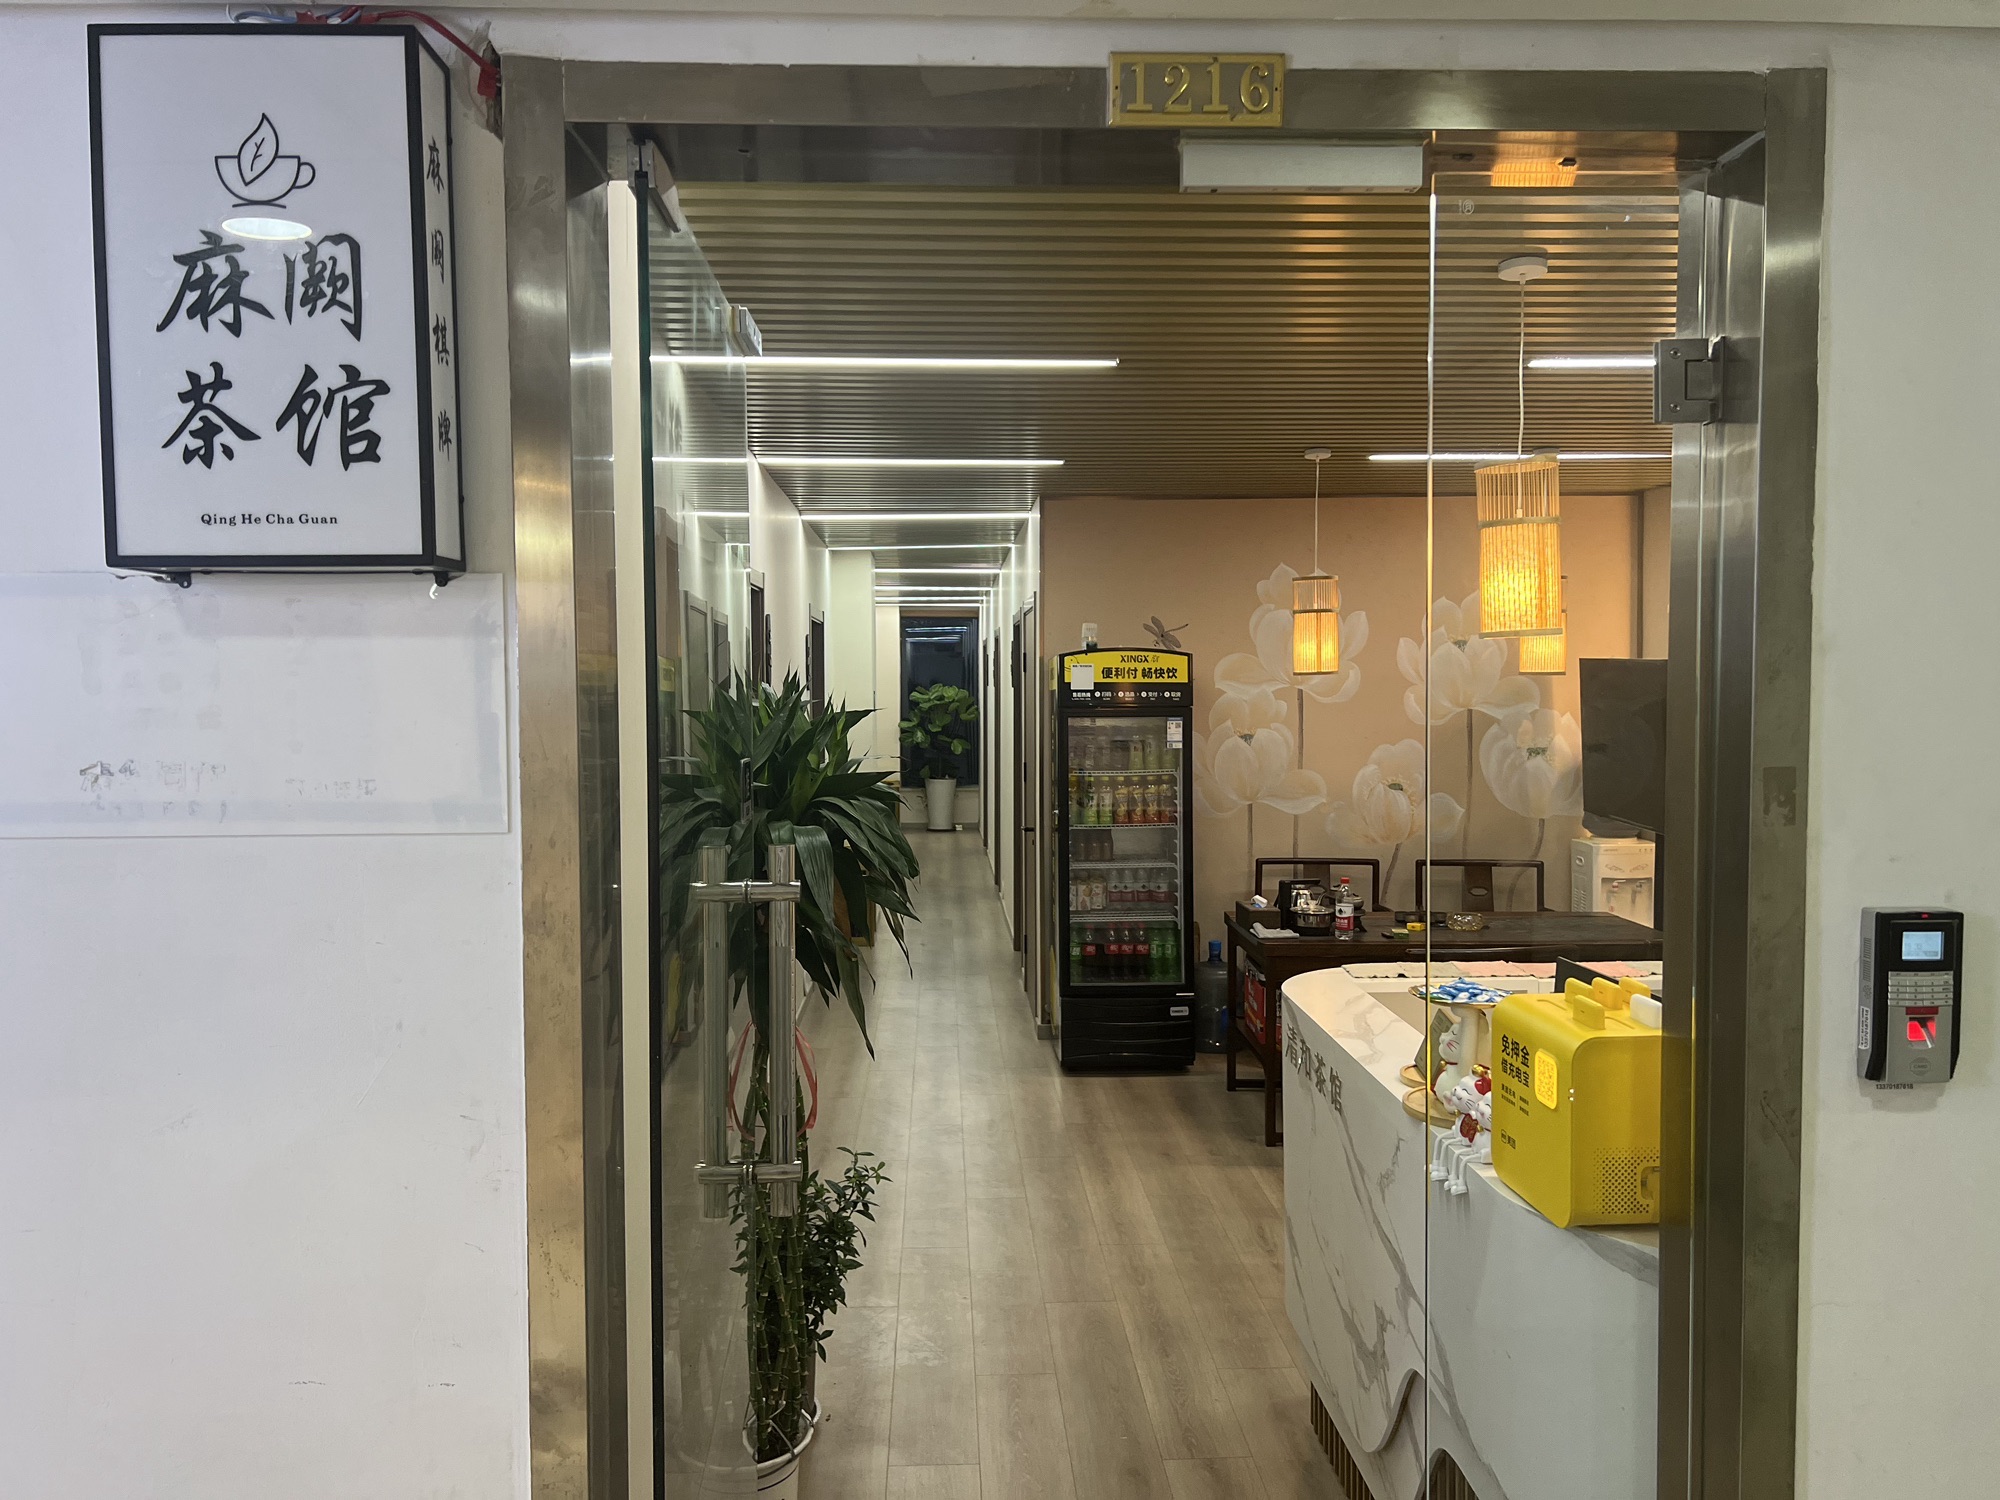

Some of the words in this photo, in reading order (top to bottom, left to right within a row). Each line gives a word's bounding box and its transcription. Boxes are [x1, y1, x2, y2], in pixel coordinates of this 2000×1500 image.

[1126, 62, 1270, 114] 1216
[162, 361, 391, 472] 茶馆
[200, 513, 237, 527] Qing
[241, 513, 262, 525] He
[265, 513, 295, 525] Cha
[298, 513, 338, 525] Guan
[1101, 667, 1138, 679] 便利付
[1141, 667, 1178, 679] 畅快饮
[1120, 654, 1149, 664] XINGX
[1501, 1034, 1530, 1069] 免押金
[1501, 1057, 1530, 1088] 借充电宝
